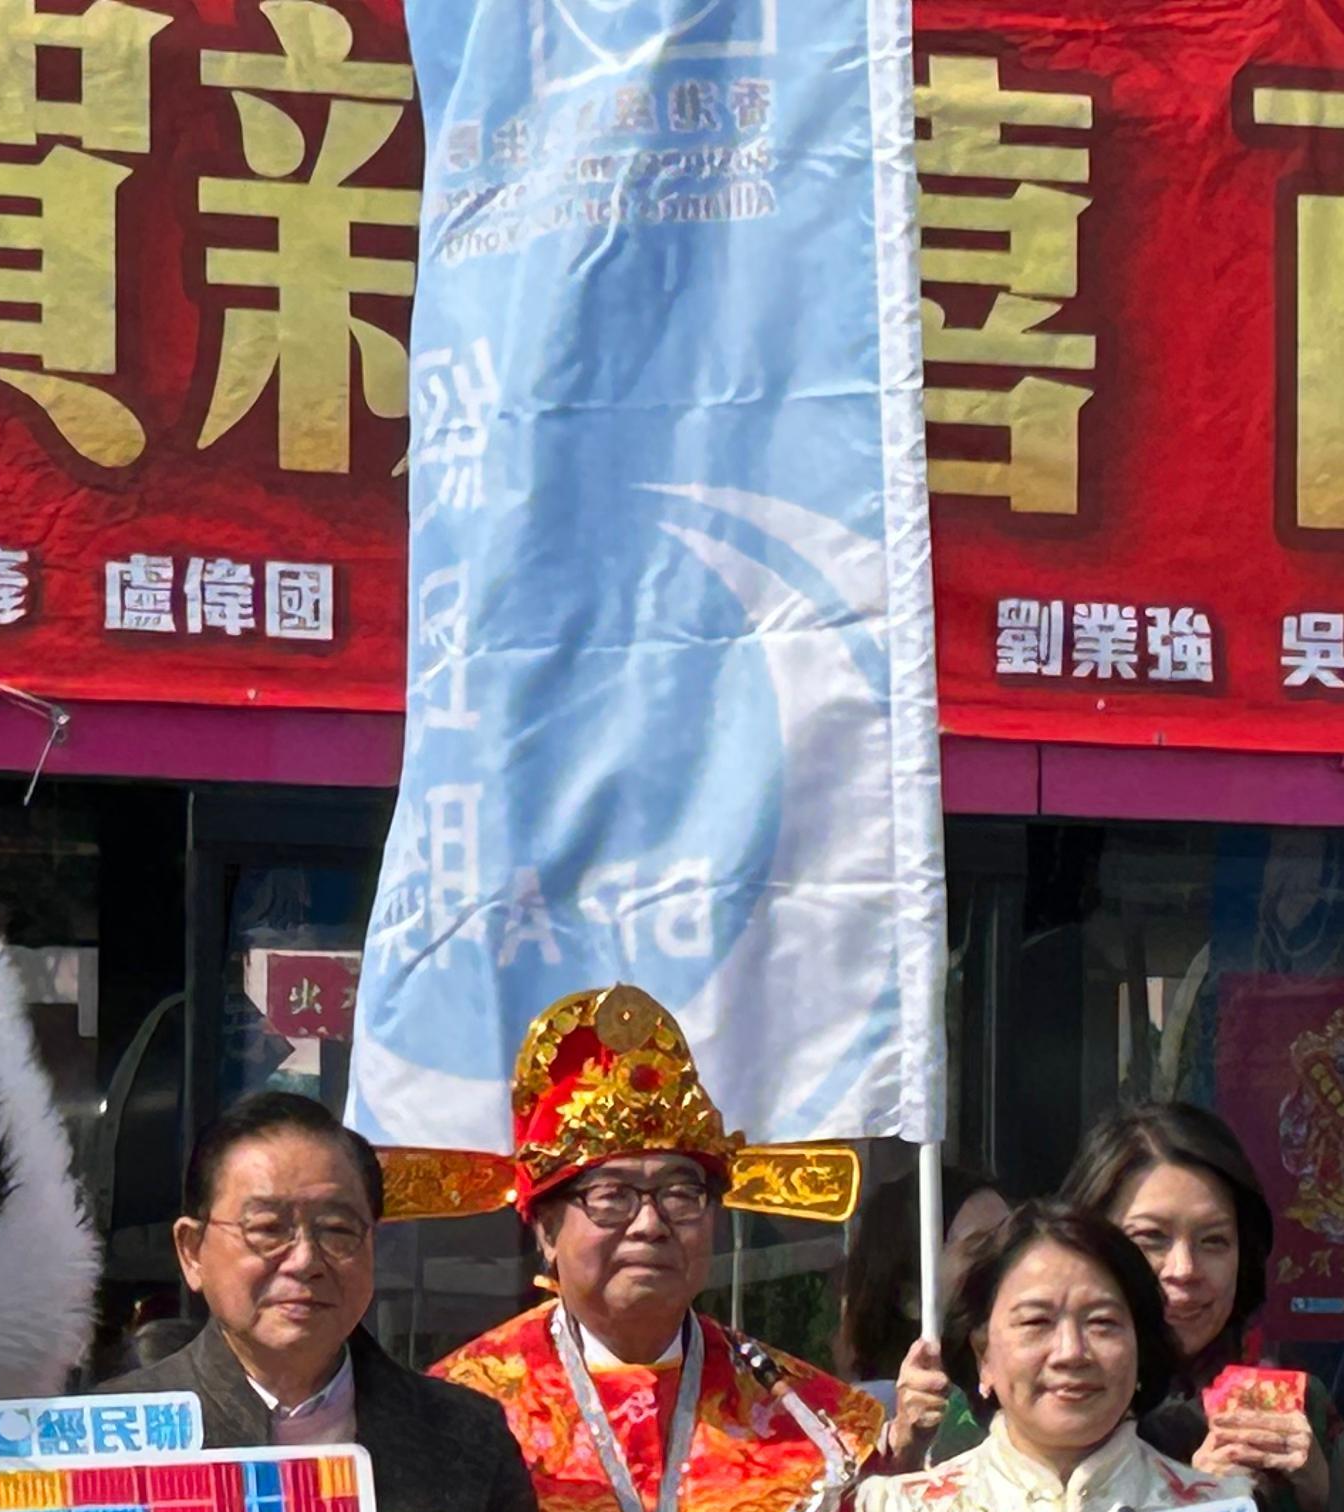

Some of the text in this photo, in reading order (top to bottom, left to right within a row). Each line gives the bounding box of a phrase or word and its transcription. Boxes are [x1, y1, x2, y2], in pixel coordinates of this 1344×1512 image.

[103, 552, 335, 641] 盧偉國
[995, 596, 1216, 684] 劉業強
[36, 1402, 194, 1455] 經民聯
